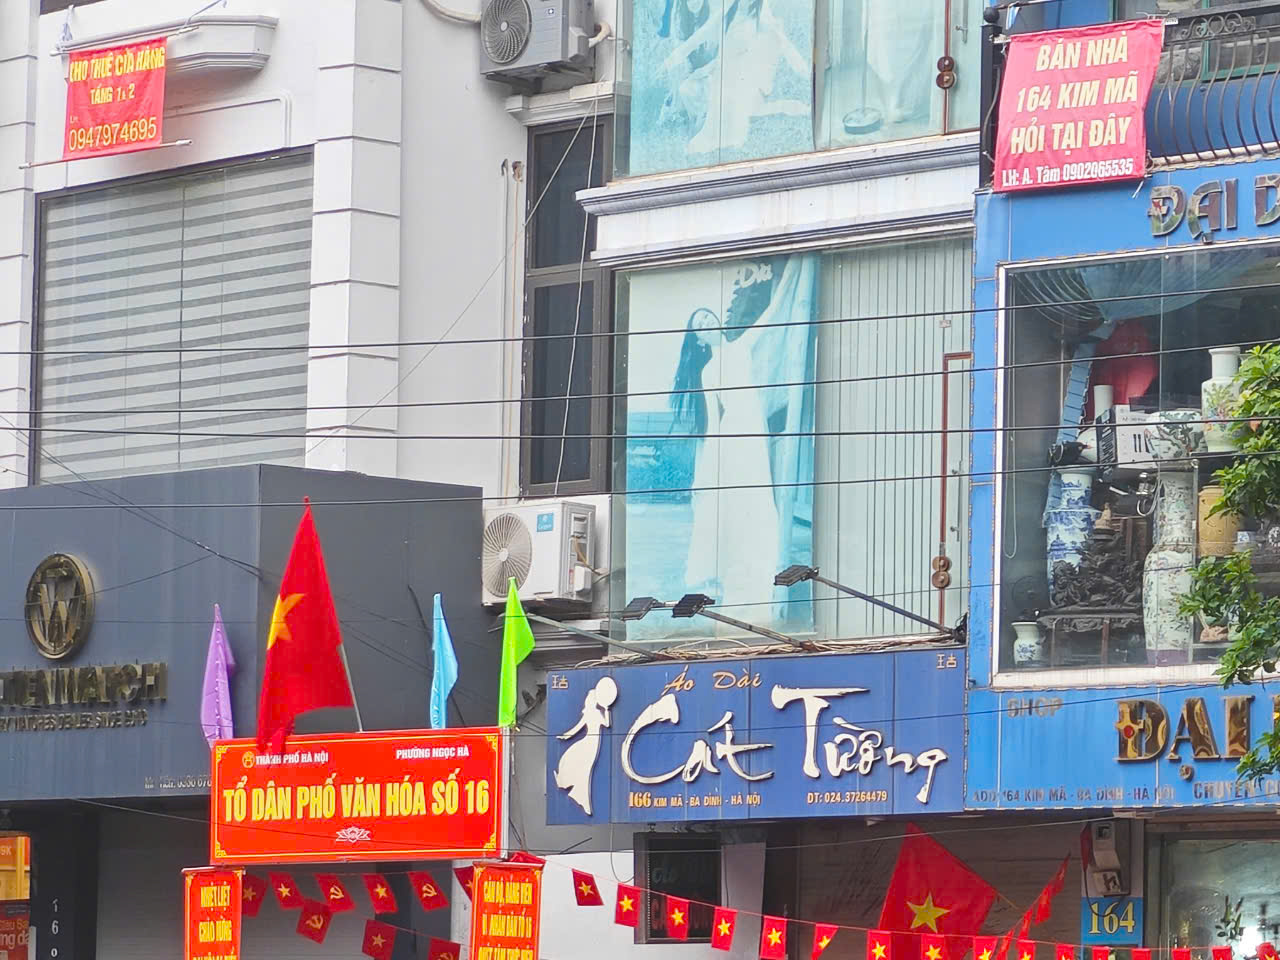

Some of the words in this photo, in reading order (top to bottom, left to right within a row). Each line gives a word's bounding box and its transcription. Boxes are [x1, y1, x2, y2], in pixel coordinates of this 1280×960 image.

[1036, 38, 1082, 72] BÁN
[1086, 31, 1128, 67] NHÀ
[1017, 85, 1051, 113] 164
[1057, 80, 1101, 109] KIM
[1103, 70, 1139, 105] MÃ
[69, 117, 157, 151] 0947974695
[1010, 117, 1045, 155] HỎI
[1052, 121, 1084, 156] TẠI
[1089, 113, 1132, 147] ĐÂY
[1002, 169, 1019, 187] LH:
[1022, 168, 1033, 185] A.
[1036, 164, 1060, 183] Tâm
[1063, 158, 1134, 181] 0902065535
[621, 693, 775, 784] Cát
[1115, 695, 1255, 781] ĐẠI
[223, 775, 248, 822] TỔ
[252, 780, 291, 822] DÂN
[297, 772, 337, 819] PHỐ
[341, 777, 380, 818] VĂN
[386, 775, 427, 817] HÓA
[432, 768, 461, 815] SỐ
[465, 780, 490, 814] 16
[628, 792, 652, 808] 166
[653, 798, 667, 808] KIM
[670, 794, 683, 807] MÃ
[824, 791, 888, 804] 024.37264479
[1088, 901, 1135, 934] 164
